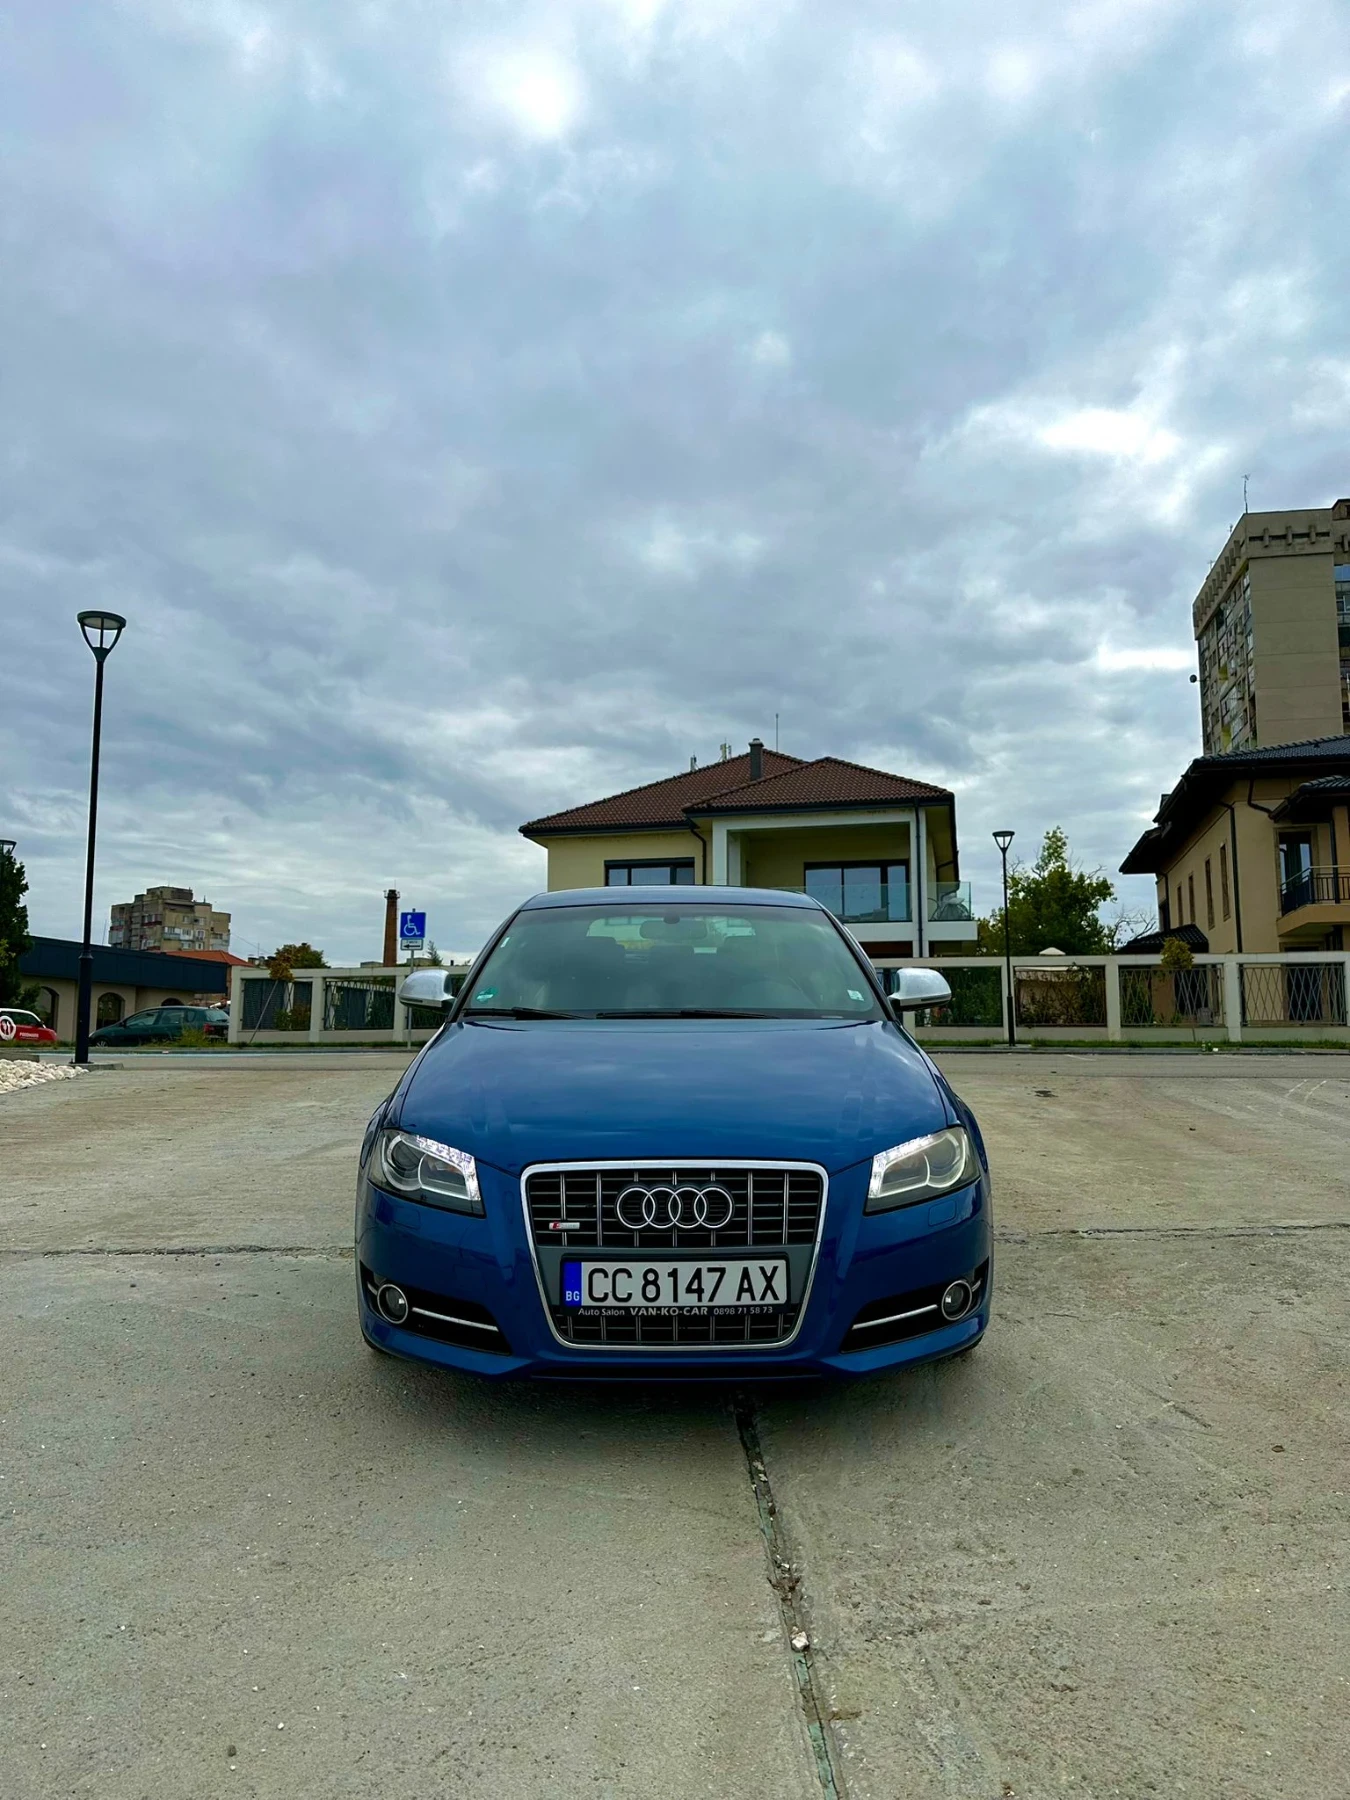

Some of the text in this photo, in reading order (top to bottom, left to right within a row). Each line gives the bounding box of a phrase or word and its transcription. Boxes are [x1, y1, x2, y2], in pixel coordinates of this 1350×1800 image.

[588, 1266, 780, 1303] CC 8147 AX
[565, 1291, 580, 1301] BG
[578, 1308, 600, 1316] Auto
[601, 1308, 625, 1316] Salon
[630, 1307, 708, 1316] VAN-KO-CAR
[713, 1307, 735, 1315] 0898
[750, 1306, 760, 1314] 58
[762, 1306, 773, 1314] 73
